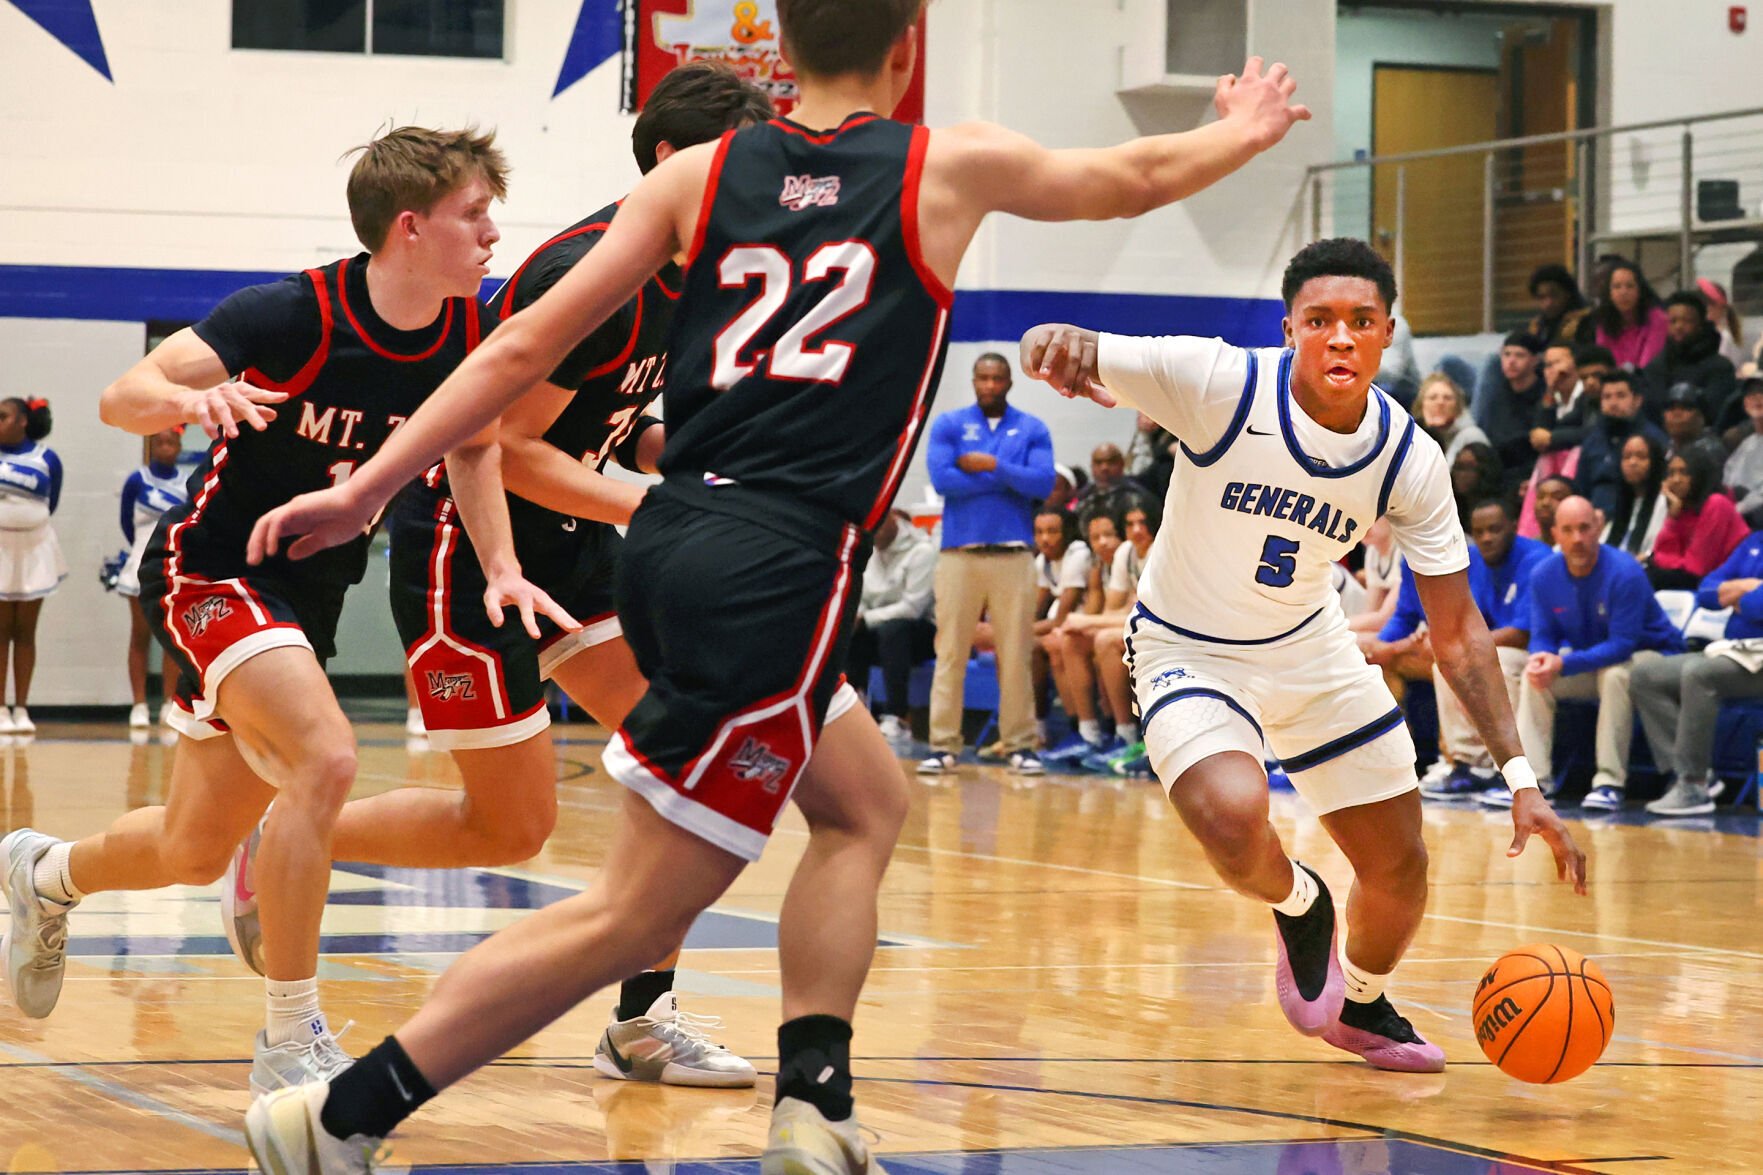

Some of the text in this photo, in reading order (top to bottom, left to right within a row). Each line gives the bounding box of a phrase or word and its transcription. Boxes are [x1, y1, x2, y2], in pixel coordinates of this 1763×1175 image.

[709, 238, 880, 392] 22
[296, 400, 365, 449] MT.
[1220, 481, 1358, 544] GENERALS
[1254, 534, 1300, 589] 5
